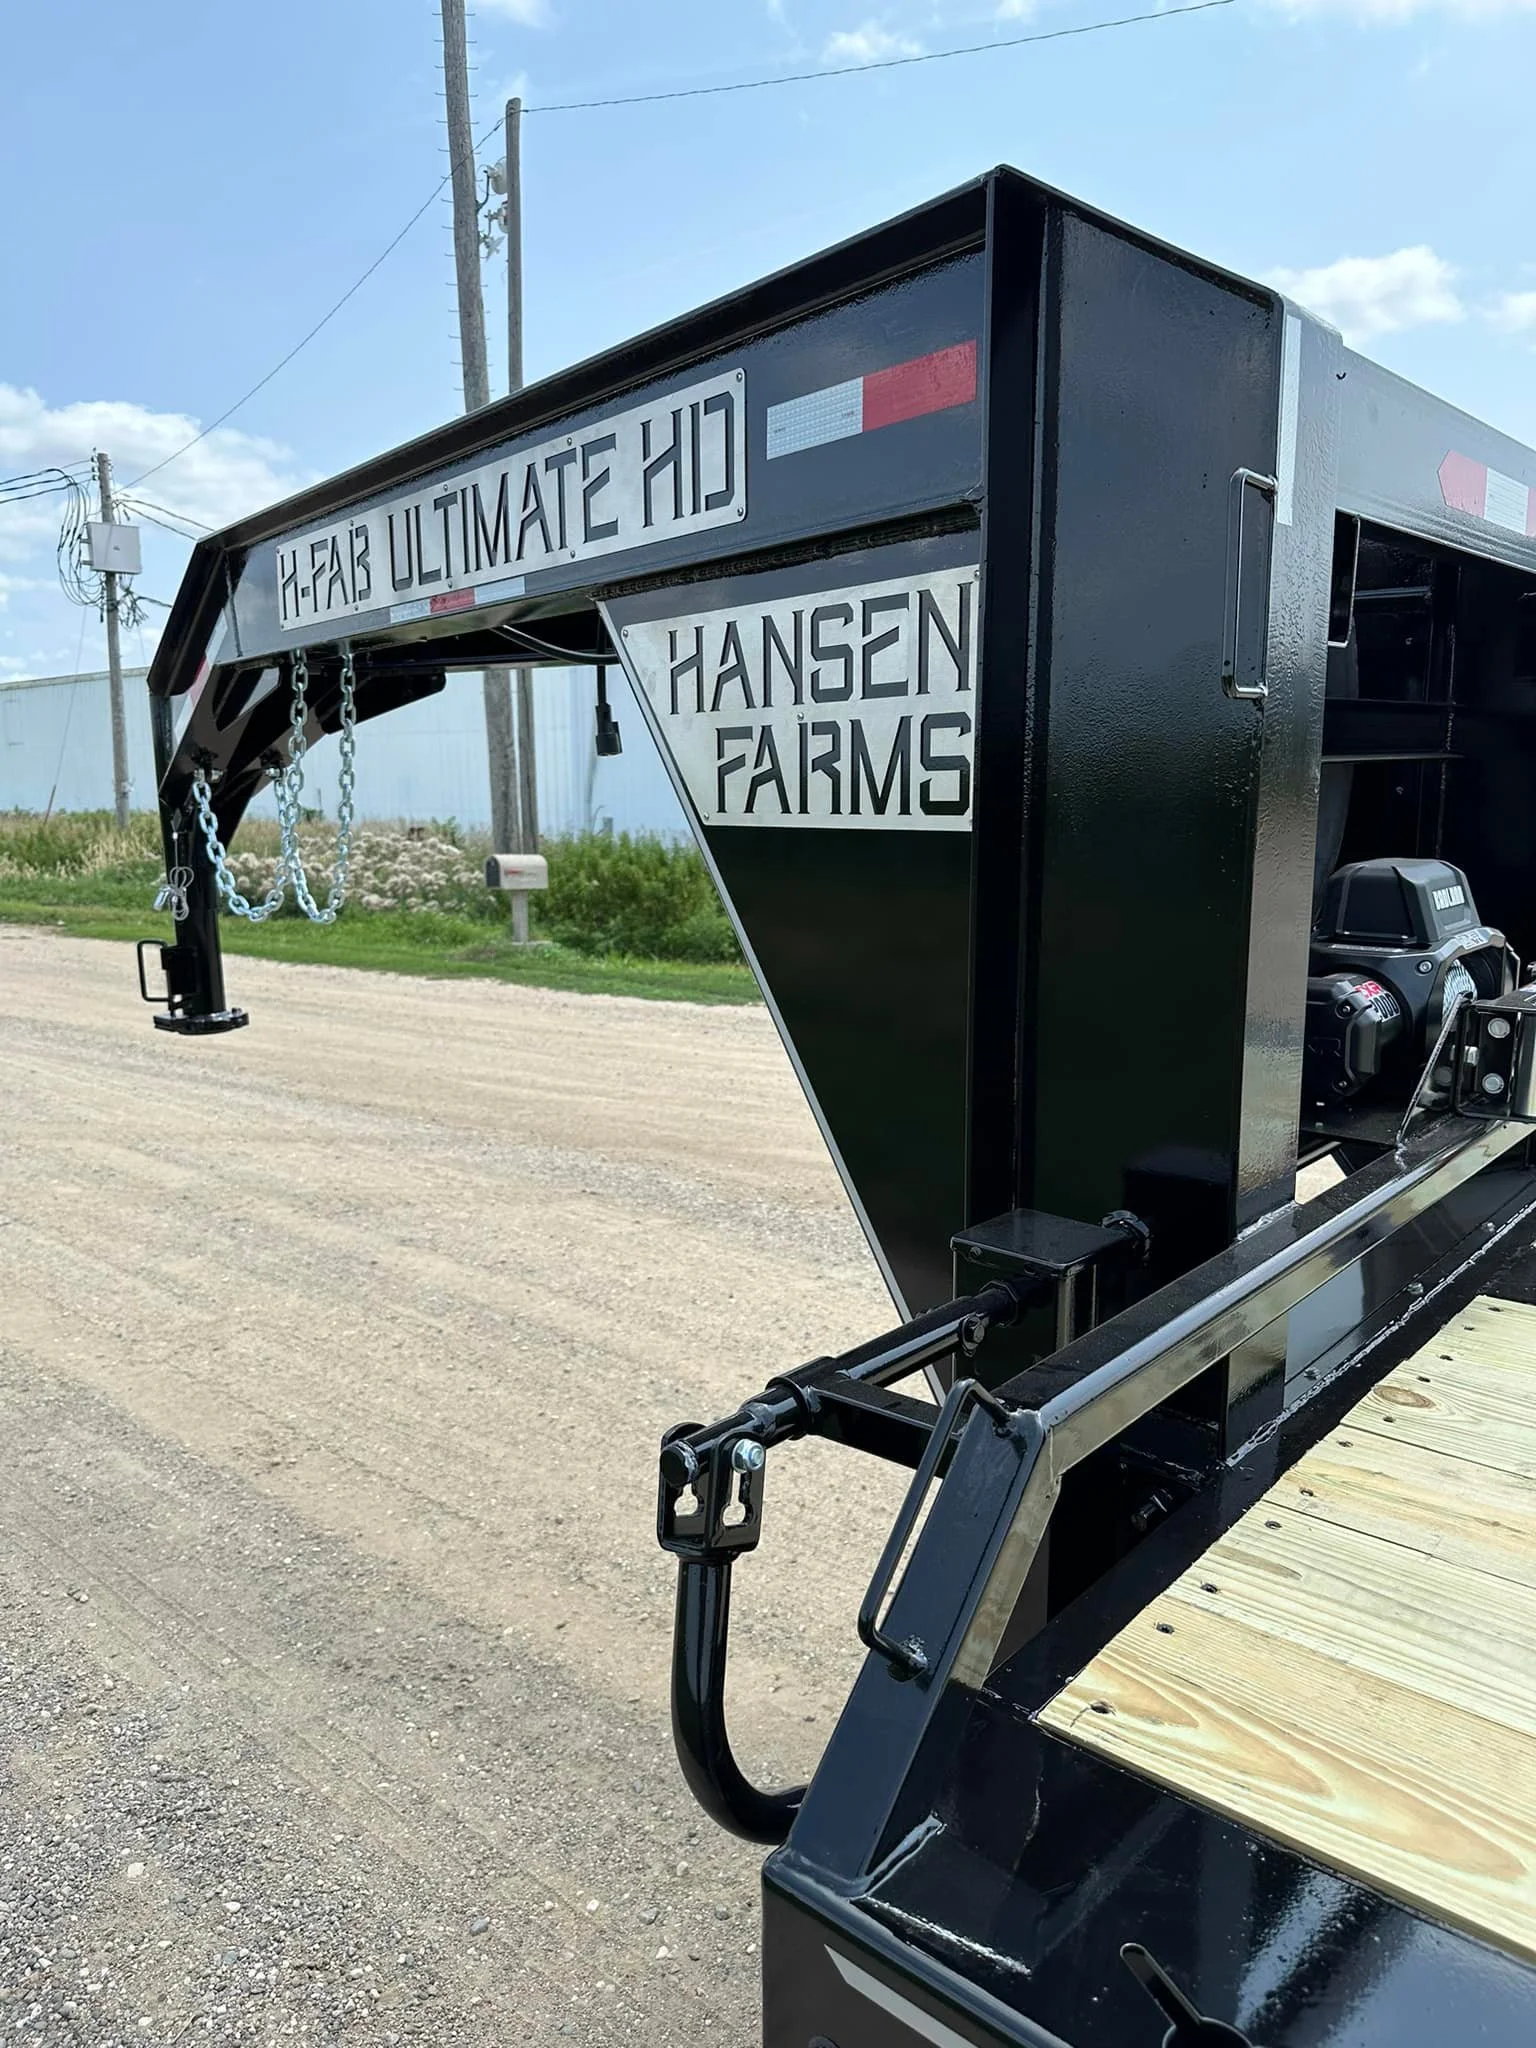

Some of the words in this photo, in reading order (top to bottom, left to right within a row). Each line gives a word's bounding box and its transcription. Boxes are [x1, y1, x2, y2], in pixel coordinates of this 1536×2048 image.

[278, 523, 371, 621] H-FAB
[387, 432, 619, 592] ULTIMATE
[640, 391, 736, 528] HD
[668, 581, 974, 715] HANSEN
[715, 711, 972, 817] FARMS
